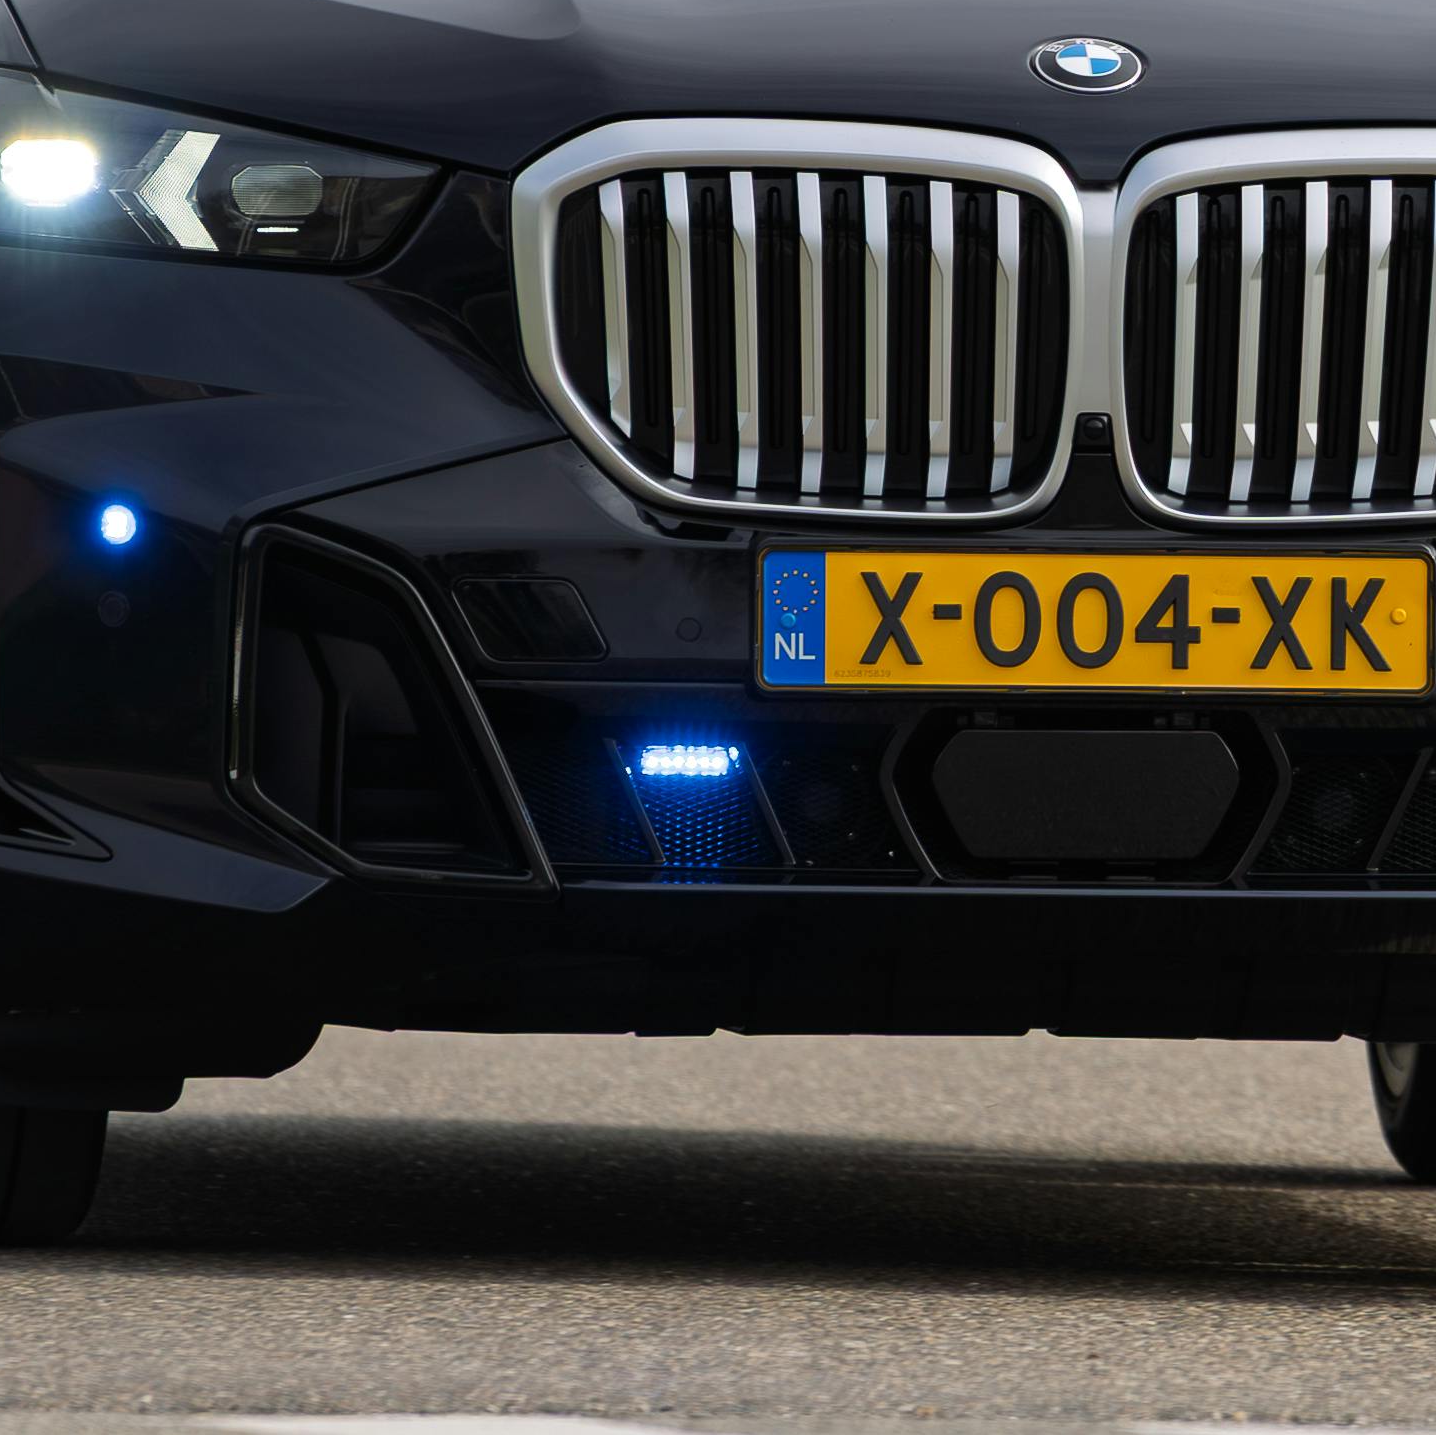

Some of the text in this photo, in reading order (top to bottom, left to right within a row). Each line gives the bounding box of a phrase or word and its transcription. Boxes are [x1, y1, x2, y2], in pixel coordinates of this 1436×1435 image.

[1045, 38, 1129, 54] BMW
[859, 571, 1392, 672] X-004-XK
[774, 632, 816, 660] NL
